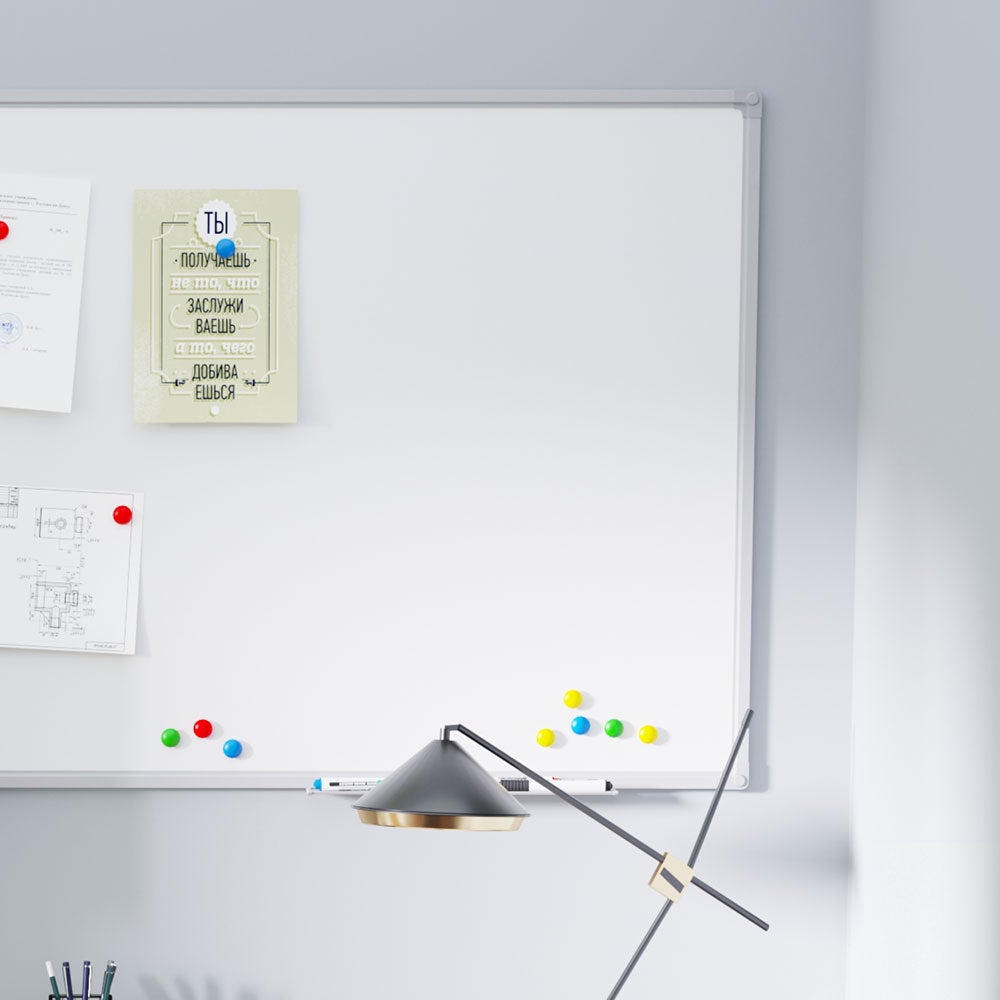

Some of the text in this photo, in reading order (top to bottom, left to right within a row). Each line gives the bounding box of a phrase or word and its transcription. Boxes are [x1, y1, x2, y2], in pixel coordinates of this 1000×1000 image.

[204, 212, 228, 234] ТЫ
[181, 252, 250, 268] ПОЛУЧАЕШЬ
[171, 278, 189, 289] не
[227, 278, 260, 289] что
[187, 298, 244, 313] ЗАСЛУЖИ
[196, 319, 236, 334] ВАЕШЬ
[223, 343, 255, 354] чего
[192, 364, 238, 381] ДОБИВА
[196, 385, 235, 400] ЕШЬСЯ
